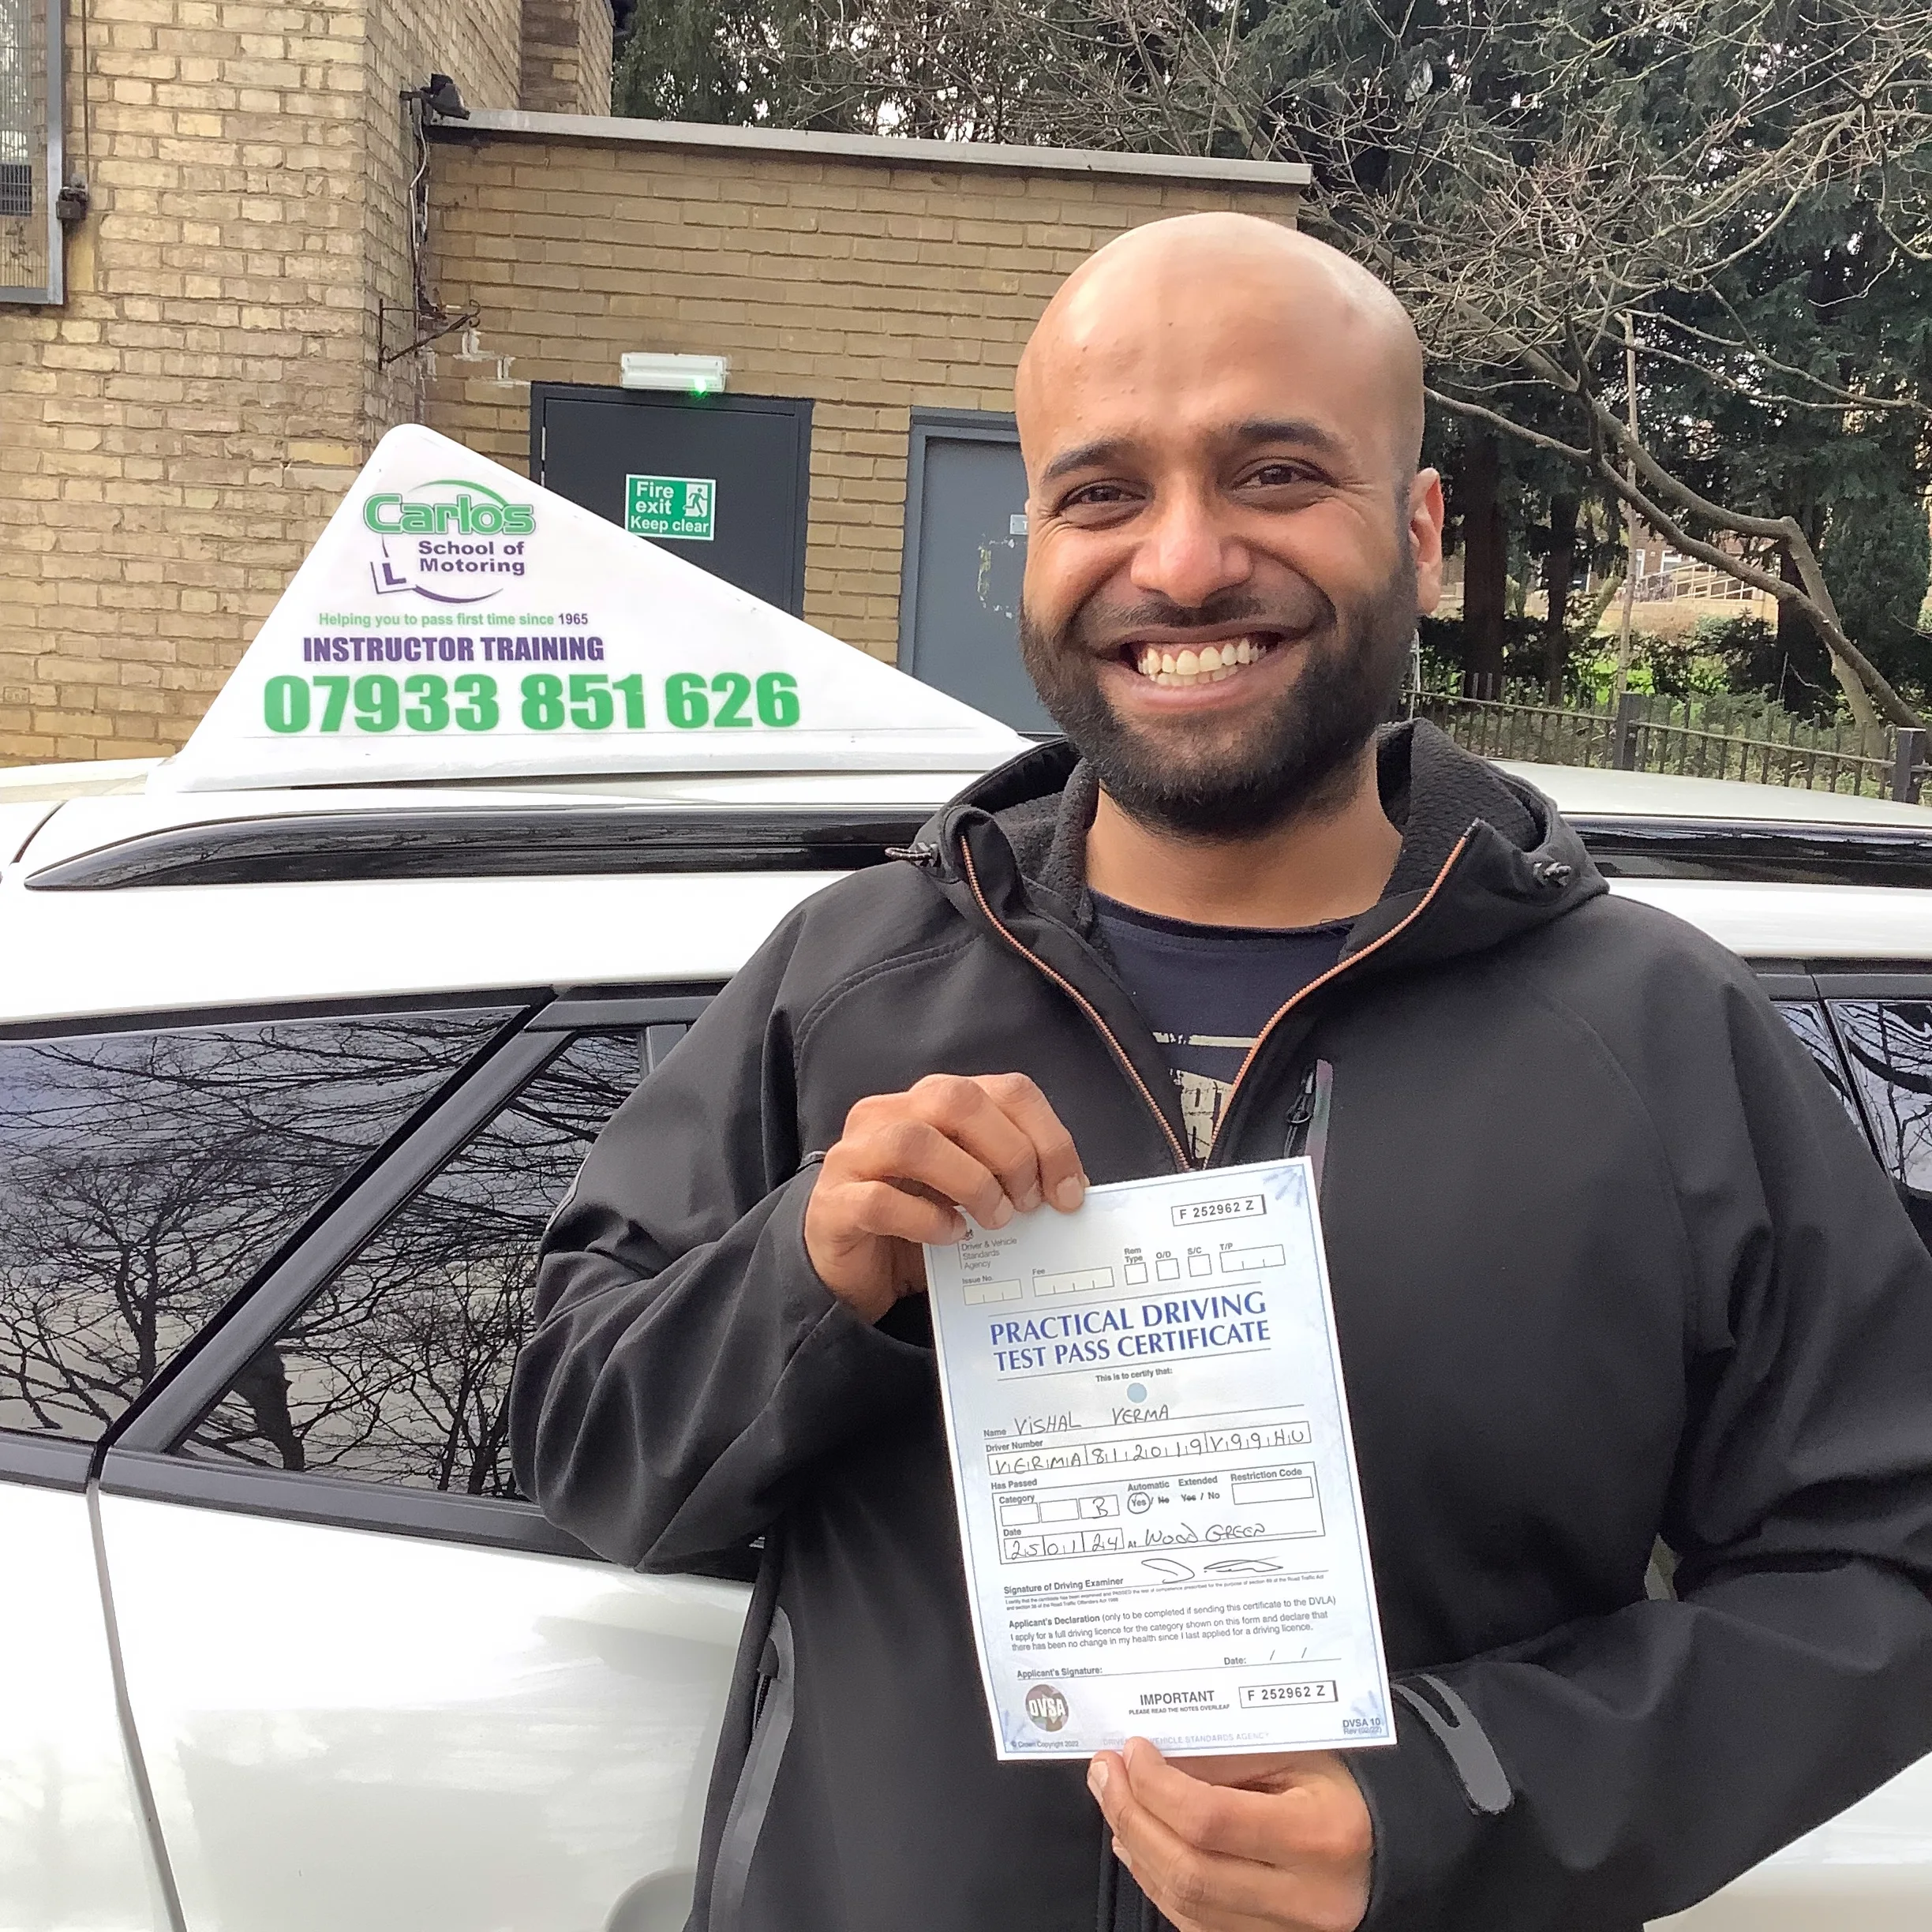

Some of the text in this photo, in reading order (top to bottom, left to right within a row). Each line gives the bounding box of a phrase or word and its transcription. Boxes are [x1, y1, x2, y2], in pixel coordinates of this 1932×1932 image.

[636, 481, 674, 499] Fire
[363, 493, 536, 535] Carlos
[635, 499, 672, 515] exit
[631, 515, 710, 533] Keep clear
[418, 540, 524, 555] School of
[420, 558, 525, 575] Motoring
[319, 613, 588, 627] Helping you to pass first time since 1965
[303, 636, 605, 661] INSTRUCTOR TRAINING
[264, 672, 800, 733] 07933 851 626
[1180, 1200, 1254, 1219] F 252962 Z
[961, 1241, 983, 1251] Driver
[991, 1237, 1017, 1247] Vehicle
[1219, 1242, 1233, 1251] T/P
[963, 1249, 1000, 1260] Standards
[1125, 1255, 1144, 1264] Type
[964, 1260, 991, 1271] Agency
[961, 1276, 981, 1285] Issue
[990, 1291, 1266, 1346] PRACTICAL DRIVING
[994, 1320, 1271, 1372] TEST PASS CERTIFICATE
[1131, 1369, 1154, 1378] certify
[1155, 1367, 1173, 1376] that:
[1112, 1404, 1169, 1425] VERMA
[983, 1428, 1006, 1437] Name
[986, 1440, 1043, 1452] Driver Number
[1230, 1468, 1302, 1481] Restriction Code
[990, 1478, 1037, 1490] Has Passed
[1127, 1476, 1218, 1492] Automatic Extended
[999, 1495, 1035, 1504] Category
[1128, 1540, 1136, 1548] At
[1004, 1585, 1042, 1595] Signature
[1054, 1581, 1083, 1589] Driving
[1085, 1578, 1124, 1587] Examiner
[1009, 1618, 1052, 1630] Applicant's
[1054, 1615, 1100, 1625] Declaration
[1102, 1613, 1121, 1623] (only
[1144, 1608, 1185, 1618] completed
[1193, 1605, 1225, 1614] sending
[1243, 1601, 1281, 1611] certificate
[1309, 1596, 1336, 1605] DVLA)
[1015, 1632, 1035, 1642] apply
[1054, 1630, 1066, 1638] full
[1068, 1629, 1093, 1638] driving
[1150, 1623, 1184, 1631] category
[1185, 1620, 1211, 1629] shown
[1262, 1614, 1278, 1623] and
[1279, 1612, 1310, 1622] declare
[1312, 1611, 1328, 1619] that
[1080, 1639, 1107, 1648] change
[1118, 1637, 1130, 1646] my
[1132, 1634, 1156, 1643] health
[1158, 1633, 1178, 1642] since
[1202, 1628, 1230, 1639] applied
[1252, 1626, 1280, 1634] driving
[1281, 1623, 1313, 1632] licence.
[1224, 1657, 1247, 1665] Date:
[1017, 1667, 1103, 1679] Applicant's Signature:
[1140, 1690, 1215, 1705] IMPORTANT
[1248, 1685, 1325, 1701] F 252962 Z
[1028, 1698, 1066, 1717] DVSA
[1342, 1717, 1381, 1728] DVSA 10
